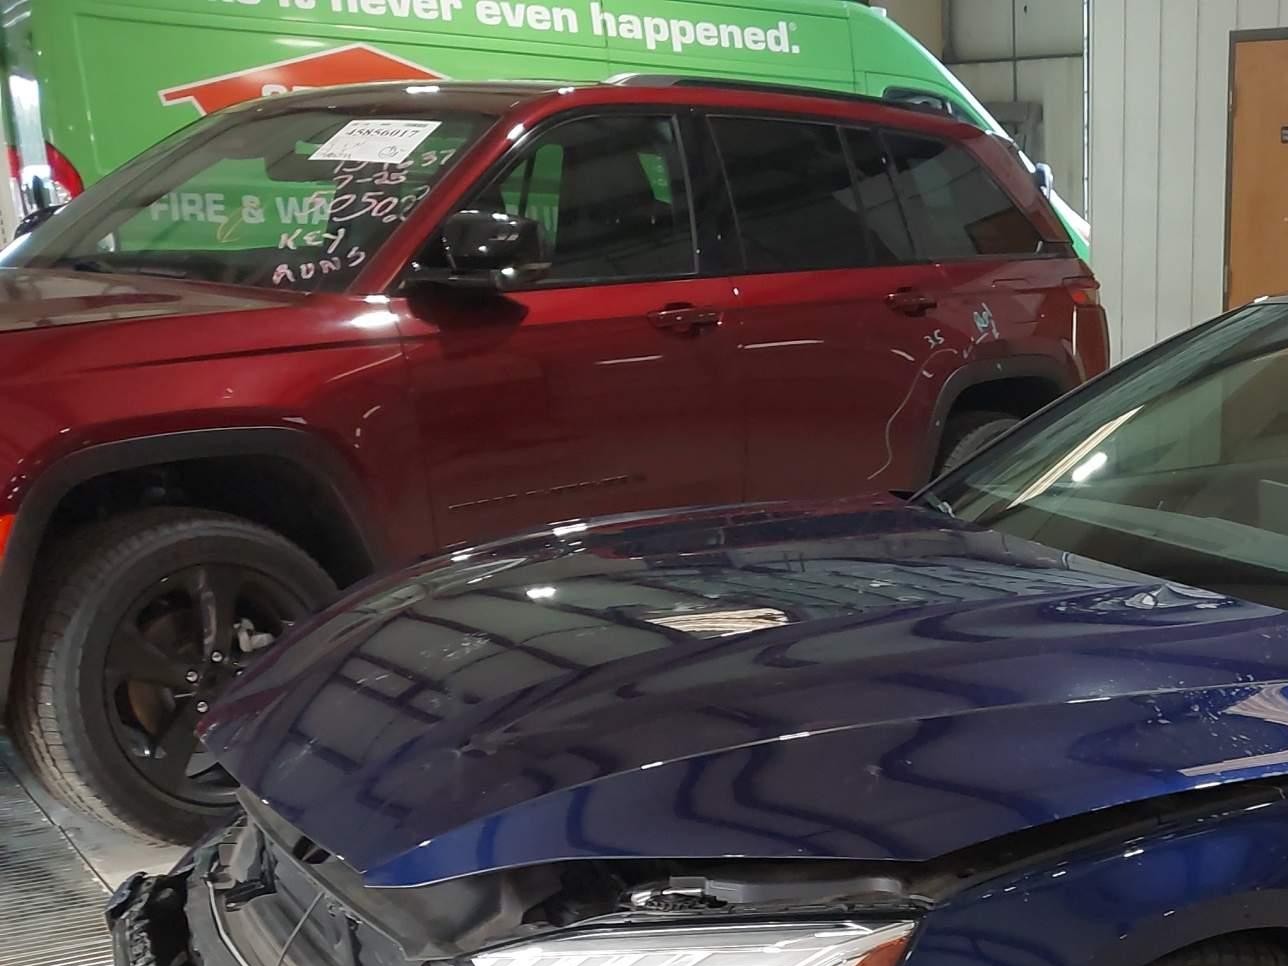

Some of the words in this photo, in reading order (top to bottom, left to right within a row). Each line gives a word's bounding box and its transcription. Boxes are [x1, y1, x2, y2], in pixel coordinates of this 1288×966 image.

[476, 0, 578, 33] even
[150, 192, 227, 224] FIRE
[240, 195, 266, 224] &
[278, 227, 346, 254] KEY
